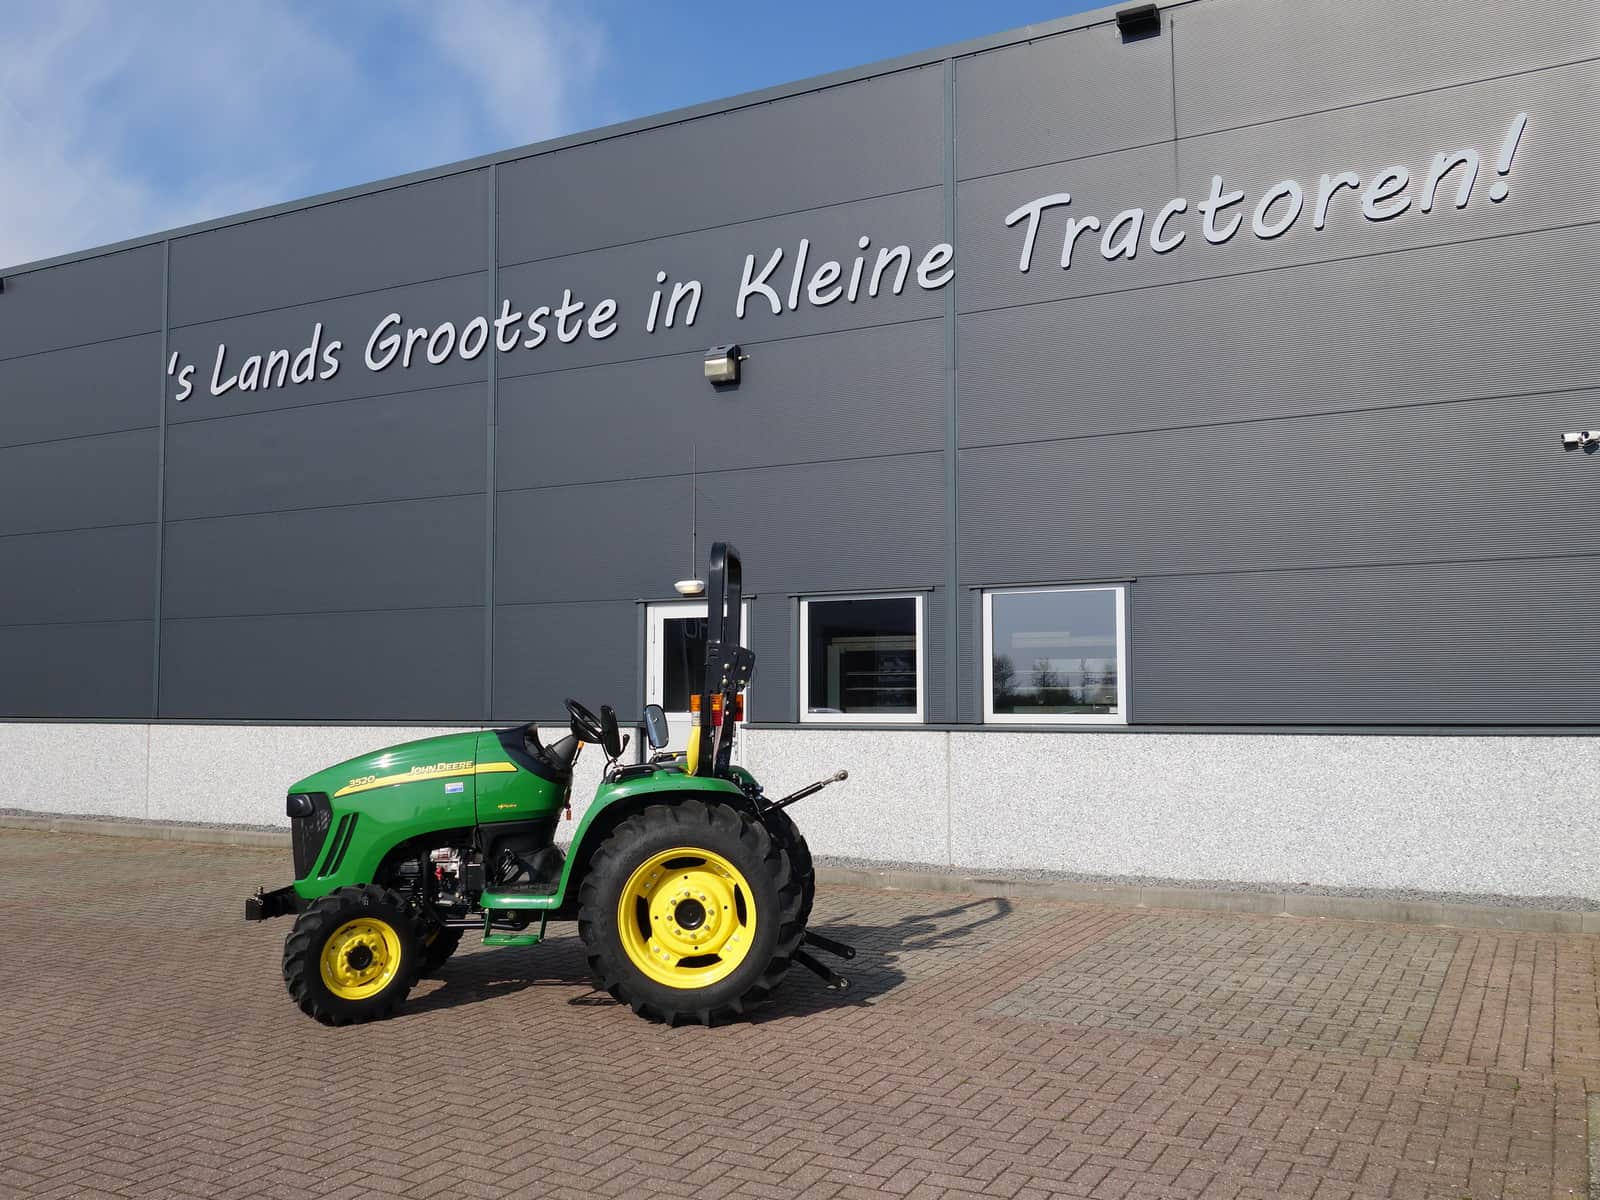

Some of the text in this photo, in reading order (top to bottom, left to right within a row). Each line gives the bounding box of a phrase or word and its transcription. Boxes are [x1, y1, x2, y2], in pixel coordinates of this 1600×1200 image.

[168, 112, 1528, 401] 's Lands Grootste in Kleine Tractoren!
